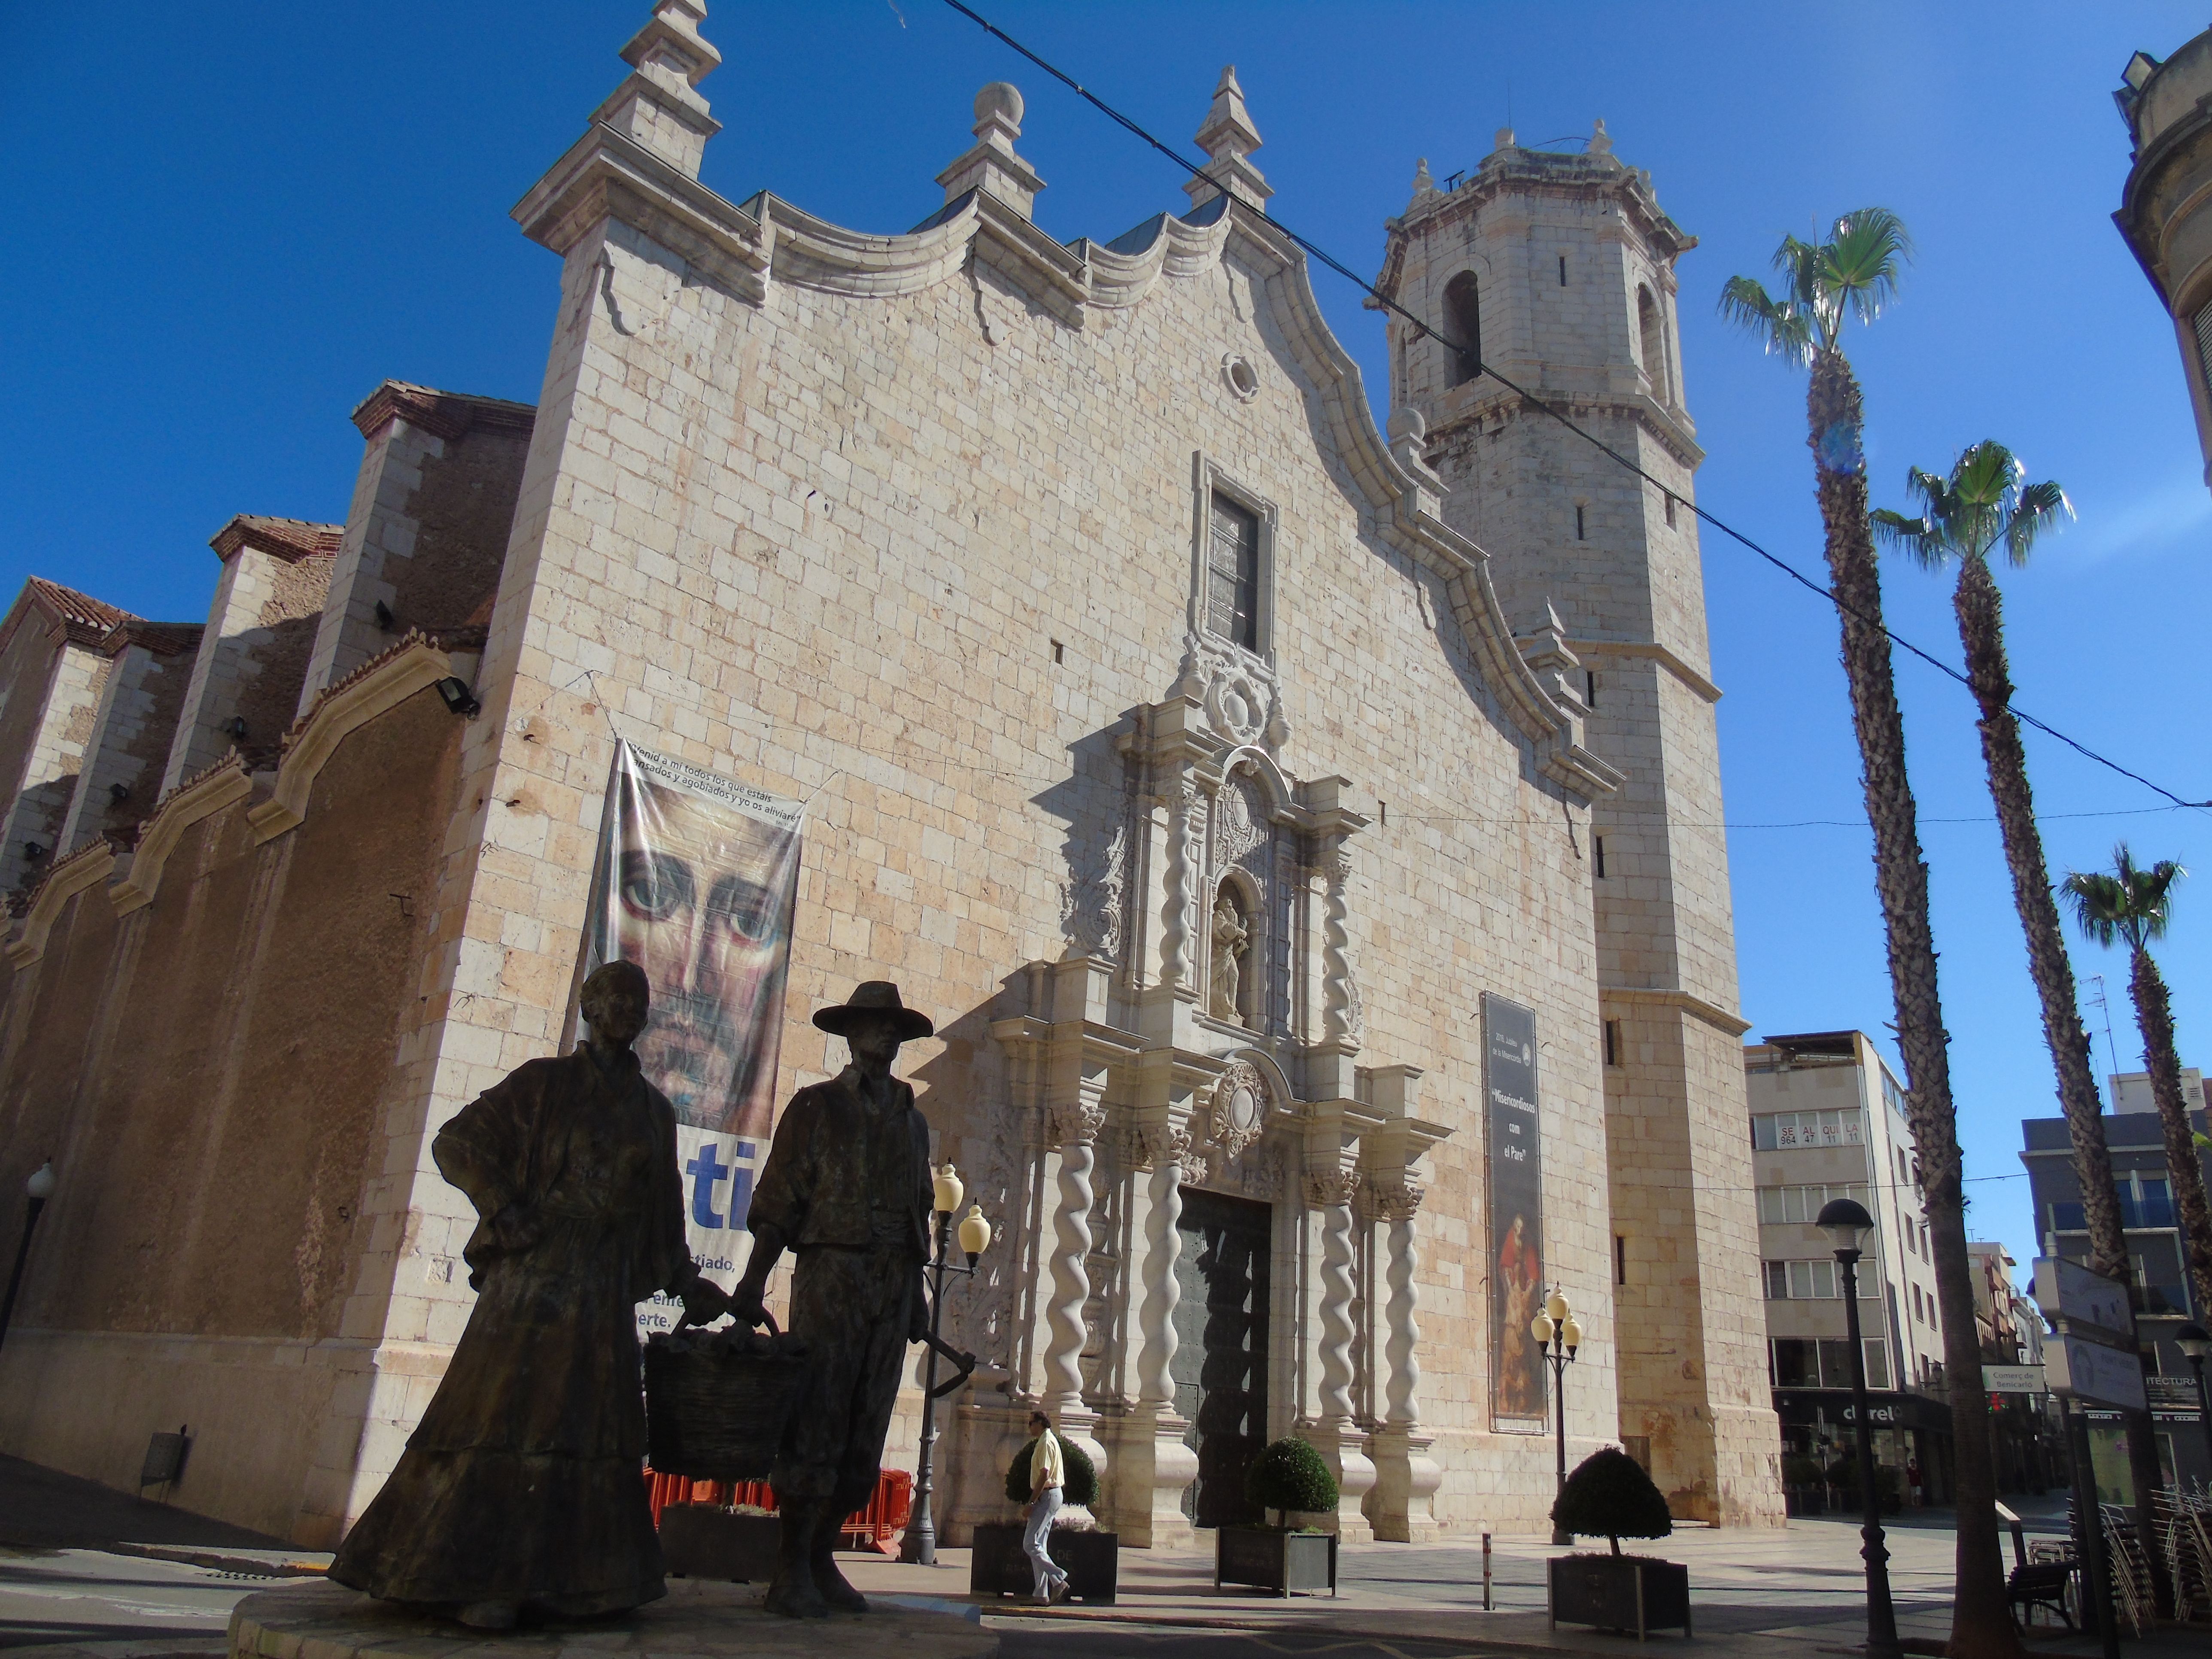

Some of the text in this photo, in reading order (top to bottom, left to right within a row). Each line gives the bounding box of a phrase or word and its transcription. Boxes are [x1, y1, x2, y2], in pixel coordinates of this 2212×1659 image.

[633, 759, 672, 778] ansados
[673, 774, 681, 782] y
[682, 777, 729, 799] agobiados
[730, 795, 737, 803] y
[738, 798, 750, 806] yo
[753, 802, 763, 811] os
[670, 761, 683, 770] mí
[685, 765, 711, 781] todos
[712, 774, 726, 786] los
[728, 782, 744, 793] que
[747, 789, 772, 802] estáis
[1492, 1047, 1497, 1055] de
[1498, 1048, 1501, 1056] la
[1509, 1123, 1520, 1134] com
[1782, 1127, 1793, 1136] SE
[1781, 1132, 1857, 1145] 964 47 11 11
[1504, 1144, 1510, 1158] el
[691, 1255, 735, 1273] tiado,
[636, 1313, 671, 1328] erte.
[2146, 1377, 2197, 1385] ITECTURA
[1843, 1405, 1894, 1421] clrel
